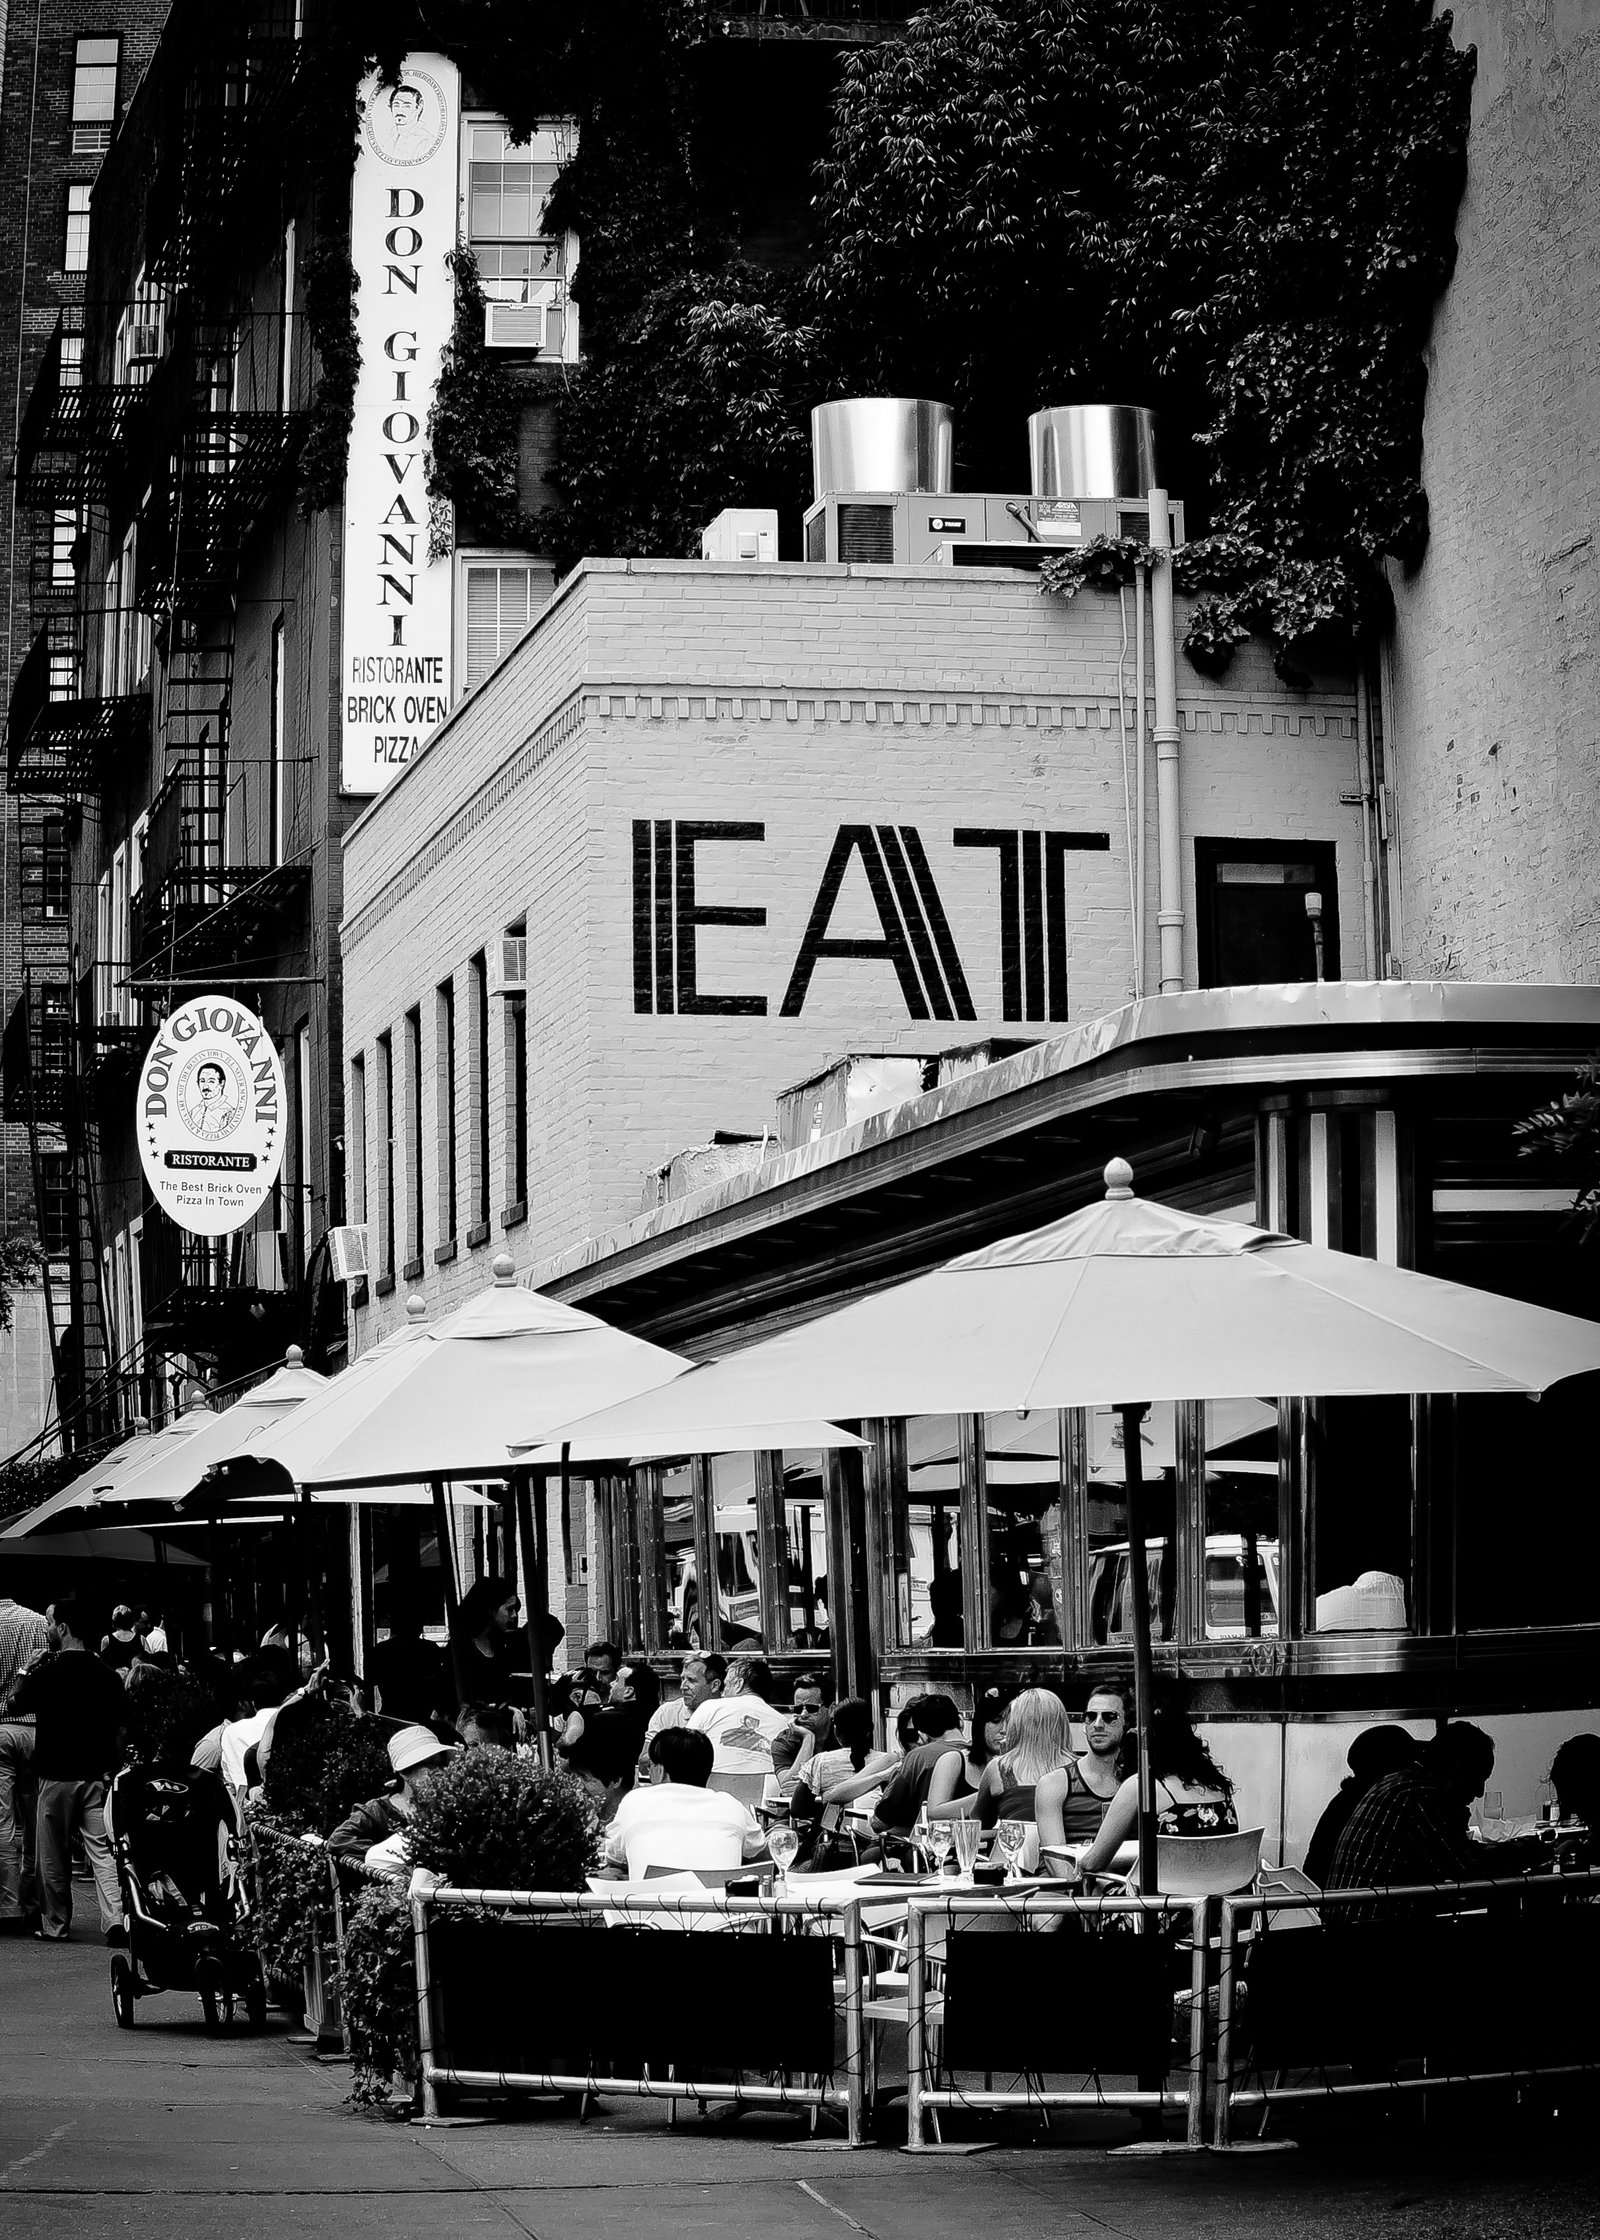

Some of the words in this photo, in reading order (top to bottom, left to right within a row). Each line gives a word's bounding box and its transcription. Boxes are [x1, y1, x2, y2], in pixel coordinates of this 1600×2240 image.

[381, 188, 424, 295] DON
[376, 330, 421, 647] GIOVANNI
[352, 656, 443, 684] RISTORANTE
[347, 695, 396, 724] BRICK
[403, 695, 448, 724] OVEN
[374, 735, 419, 763] PIZZA
[632, 818, 1111, 1023] EAT
[145, 1039, 178, 1119] DON
[171, 1006, 278, 1125] GIOVANNI
[171, 1153, 250, 1169] RISTORANTE
[160, 1180, 178, 1192] The
[181, 1181, 204, 1193] Best
[207, 1182, 233, 1194] Brick
[236, 1183, 262, 1195] Oven
[176, 1194, 202, 1206] Pizza
[205, 1195, 215, 1206] In
[217, 1196, 244, 1208] Town
